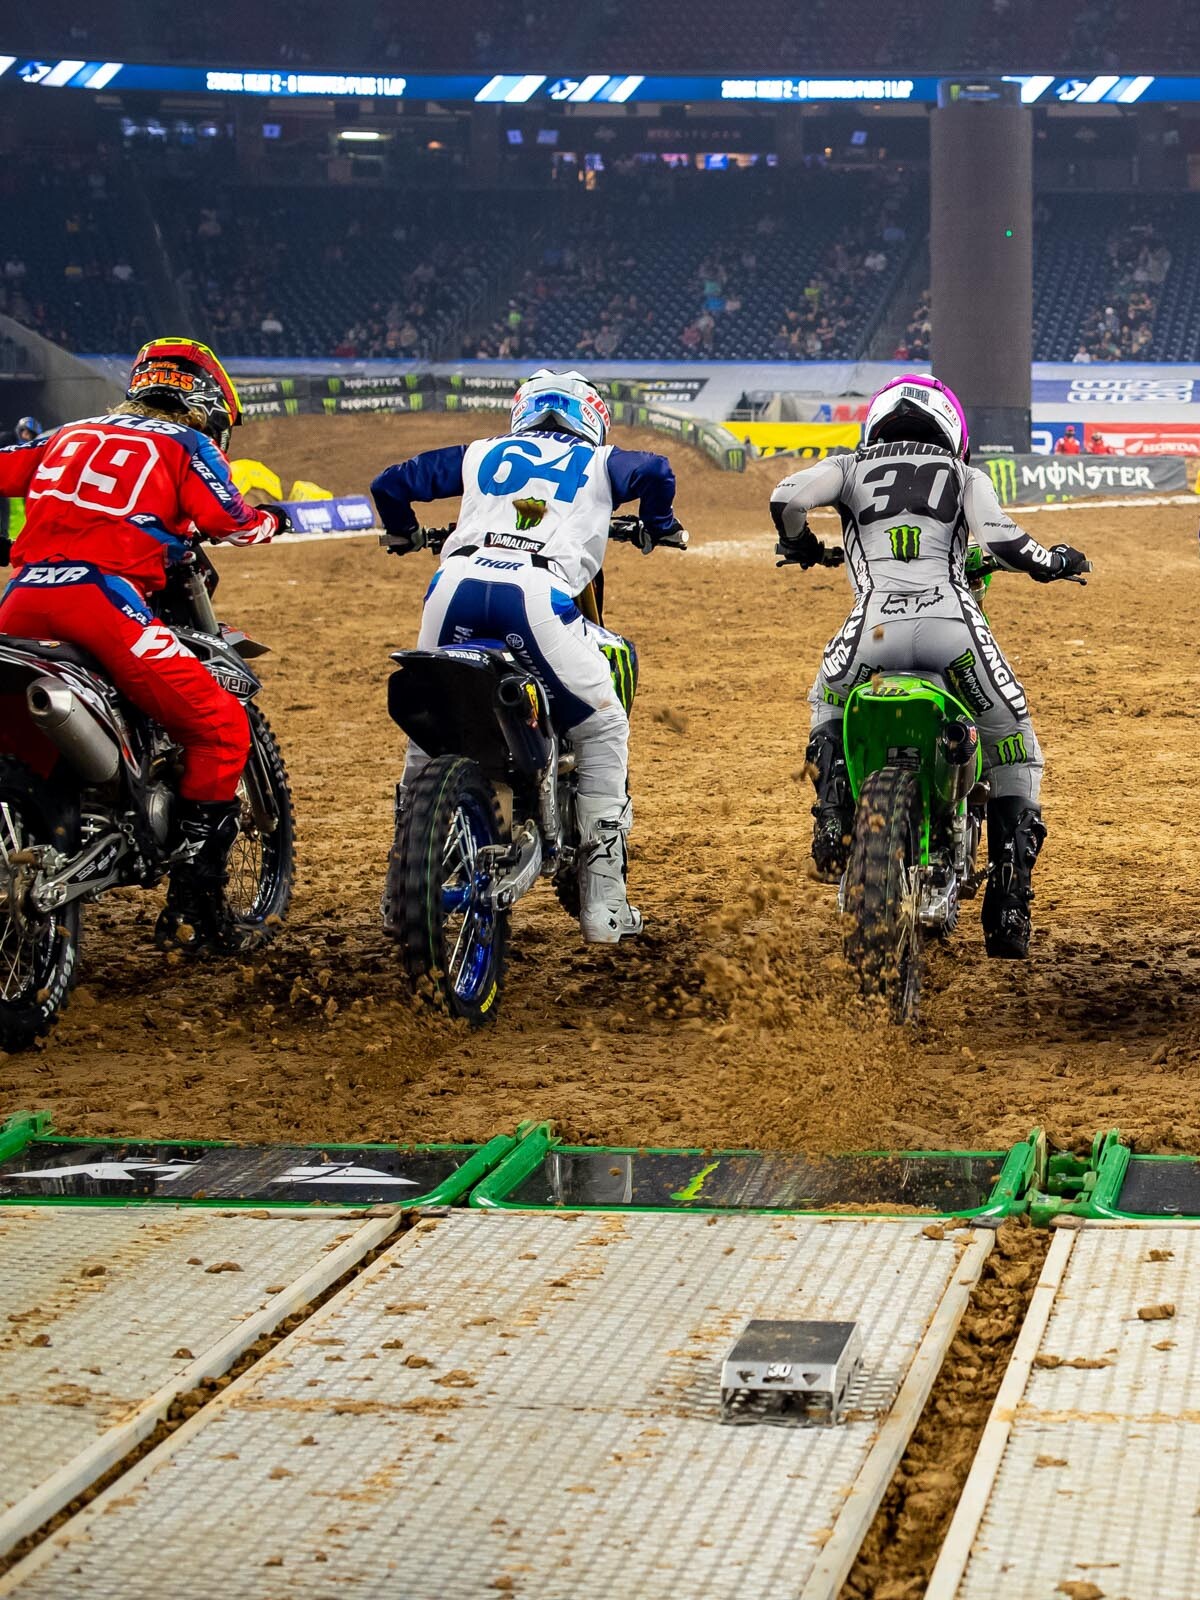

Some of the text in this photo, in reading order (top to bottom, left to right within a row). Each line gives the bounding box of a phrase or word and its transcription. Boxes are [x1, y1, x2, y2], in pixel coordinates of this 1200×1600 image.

[583, 407, 596, 424] BELL
[1142, 442, 1200, 453] HONDA
[29, 430, 159, 515] 99
[478, 440, 595, 503] 64
[1022, 461, 1154, 490] MONSTER
[859, 462, 960, 525] 30
[474, 557, 525, 571] THOR
[1020, 539, 1053, 567] FOX
[963, 667, 992, 711] MONSTER
[767, 1363, 792, 1377] 30
